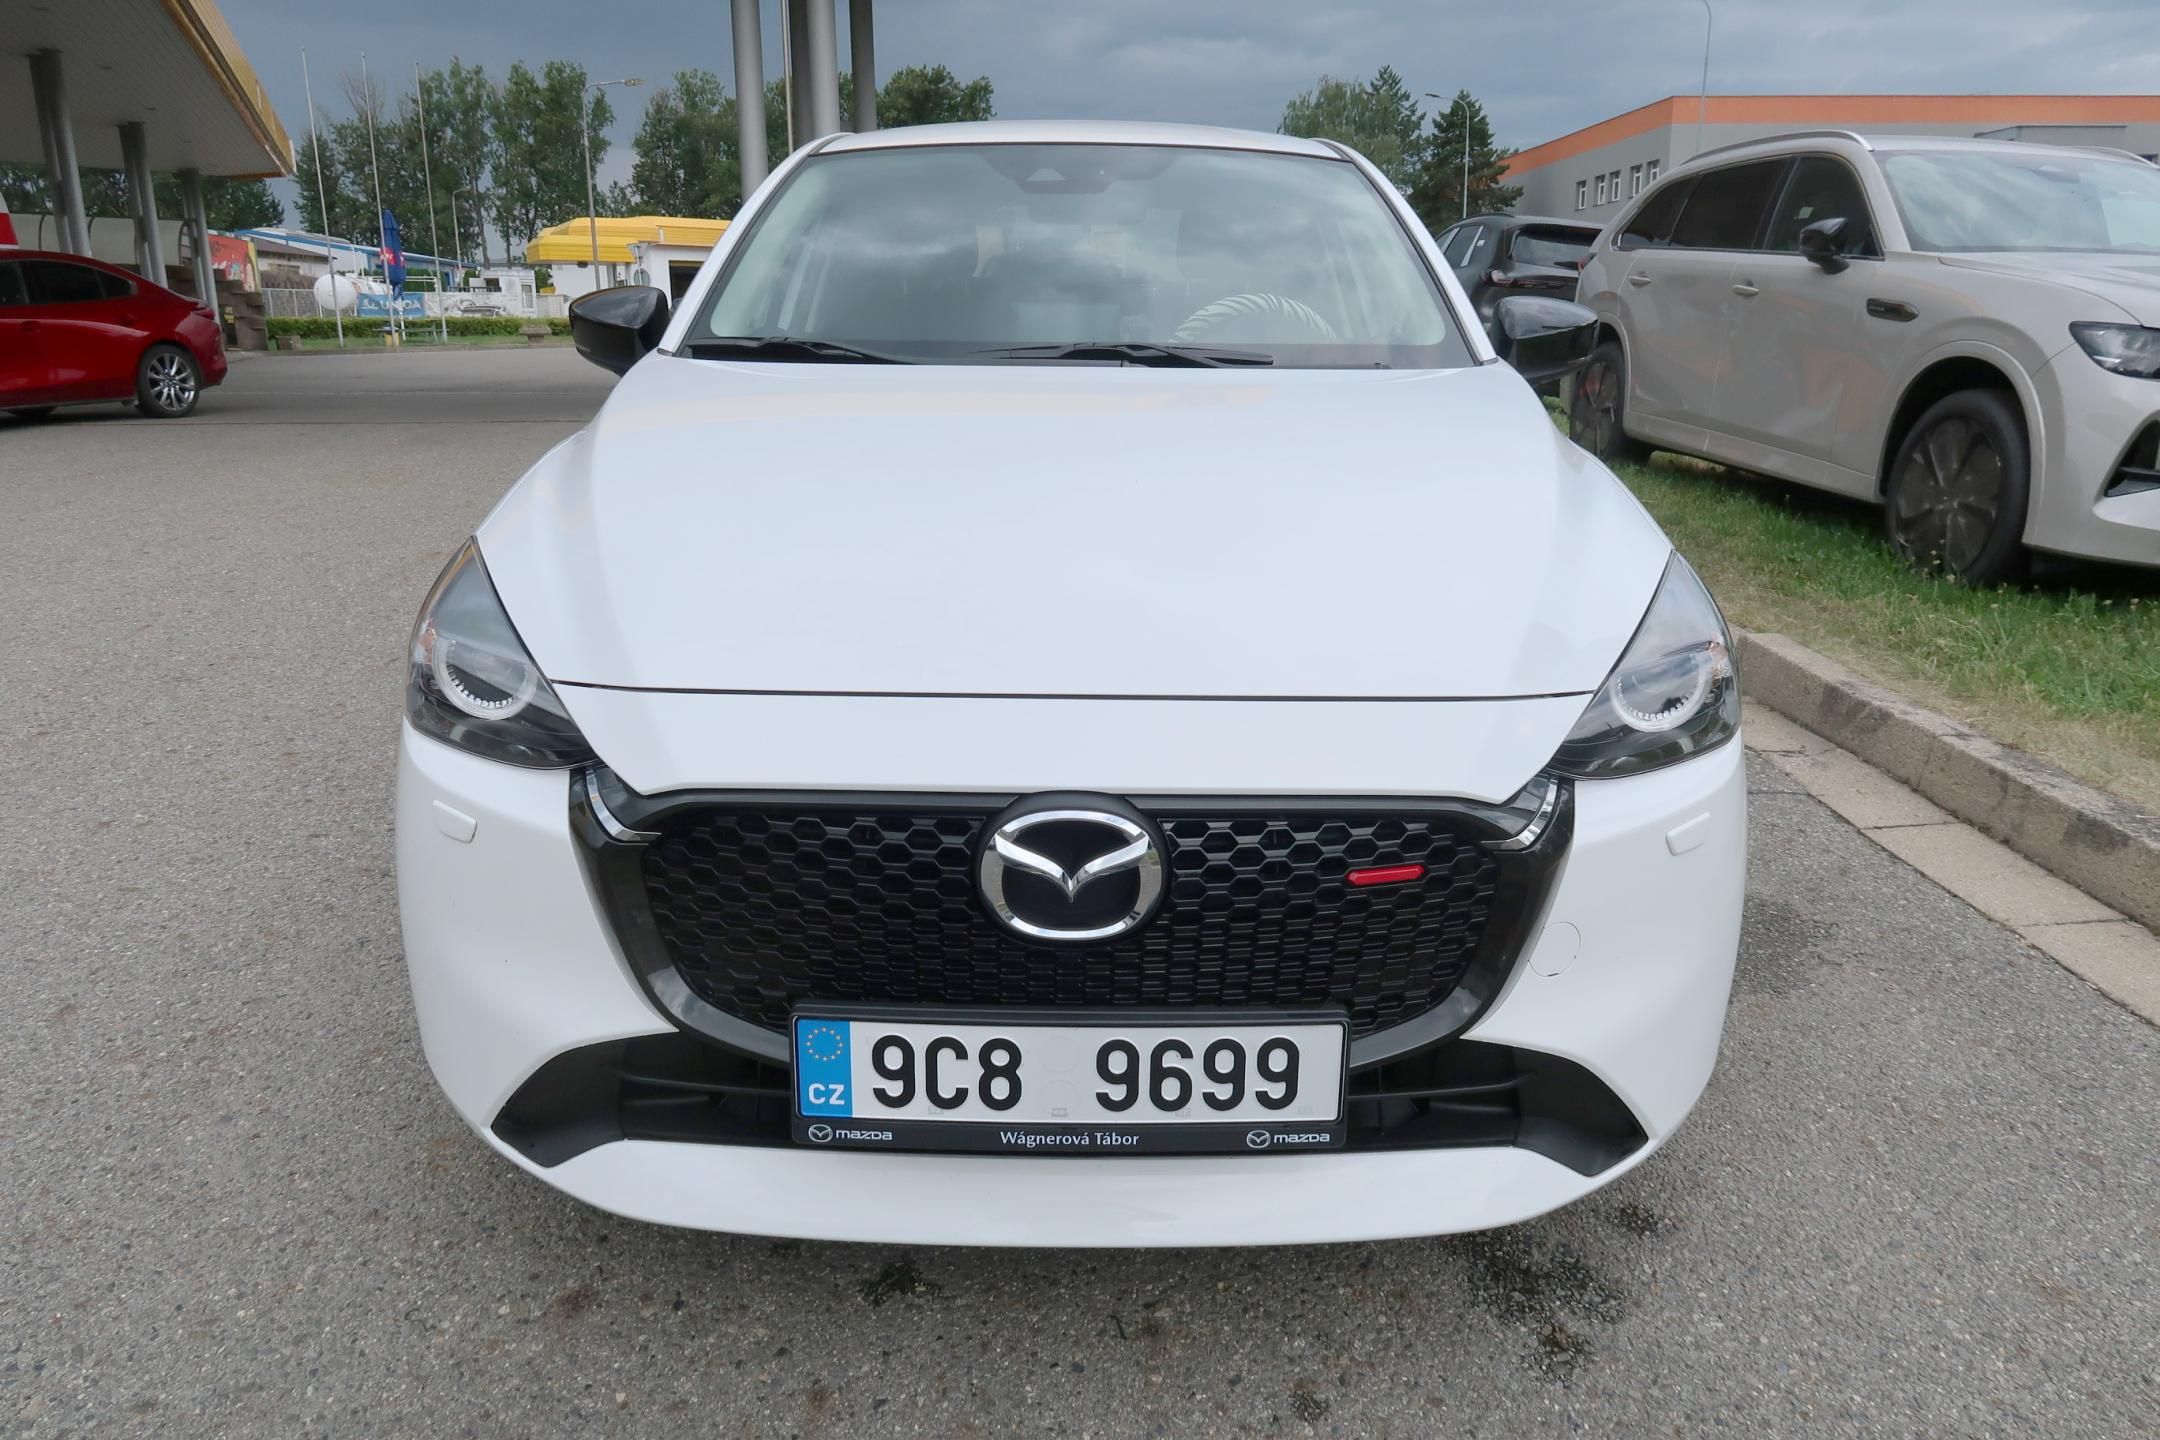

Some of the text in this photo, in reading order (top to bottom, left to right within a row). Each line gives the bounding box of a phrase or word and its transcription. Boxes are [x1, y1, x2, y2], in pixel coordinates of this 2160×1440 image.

[379, 299, 422, 310] UNQA
[871, 1034, 1300, 1112] 9C8 9699
[808, 1083, 845, 1105] CZ
[835, 1128, 893, 1141] mazda
[1000, 1131, 1140, 1148] Wágnerová Tábor
[1273, 1133, 1331, 1144] mazda
